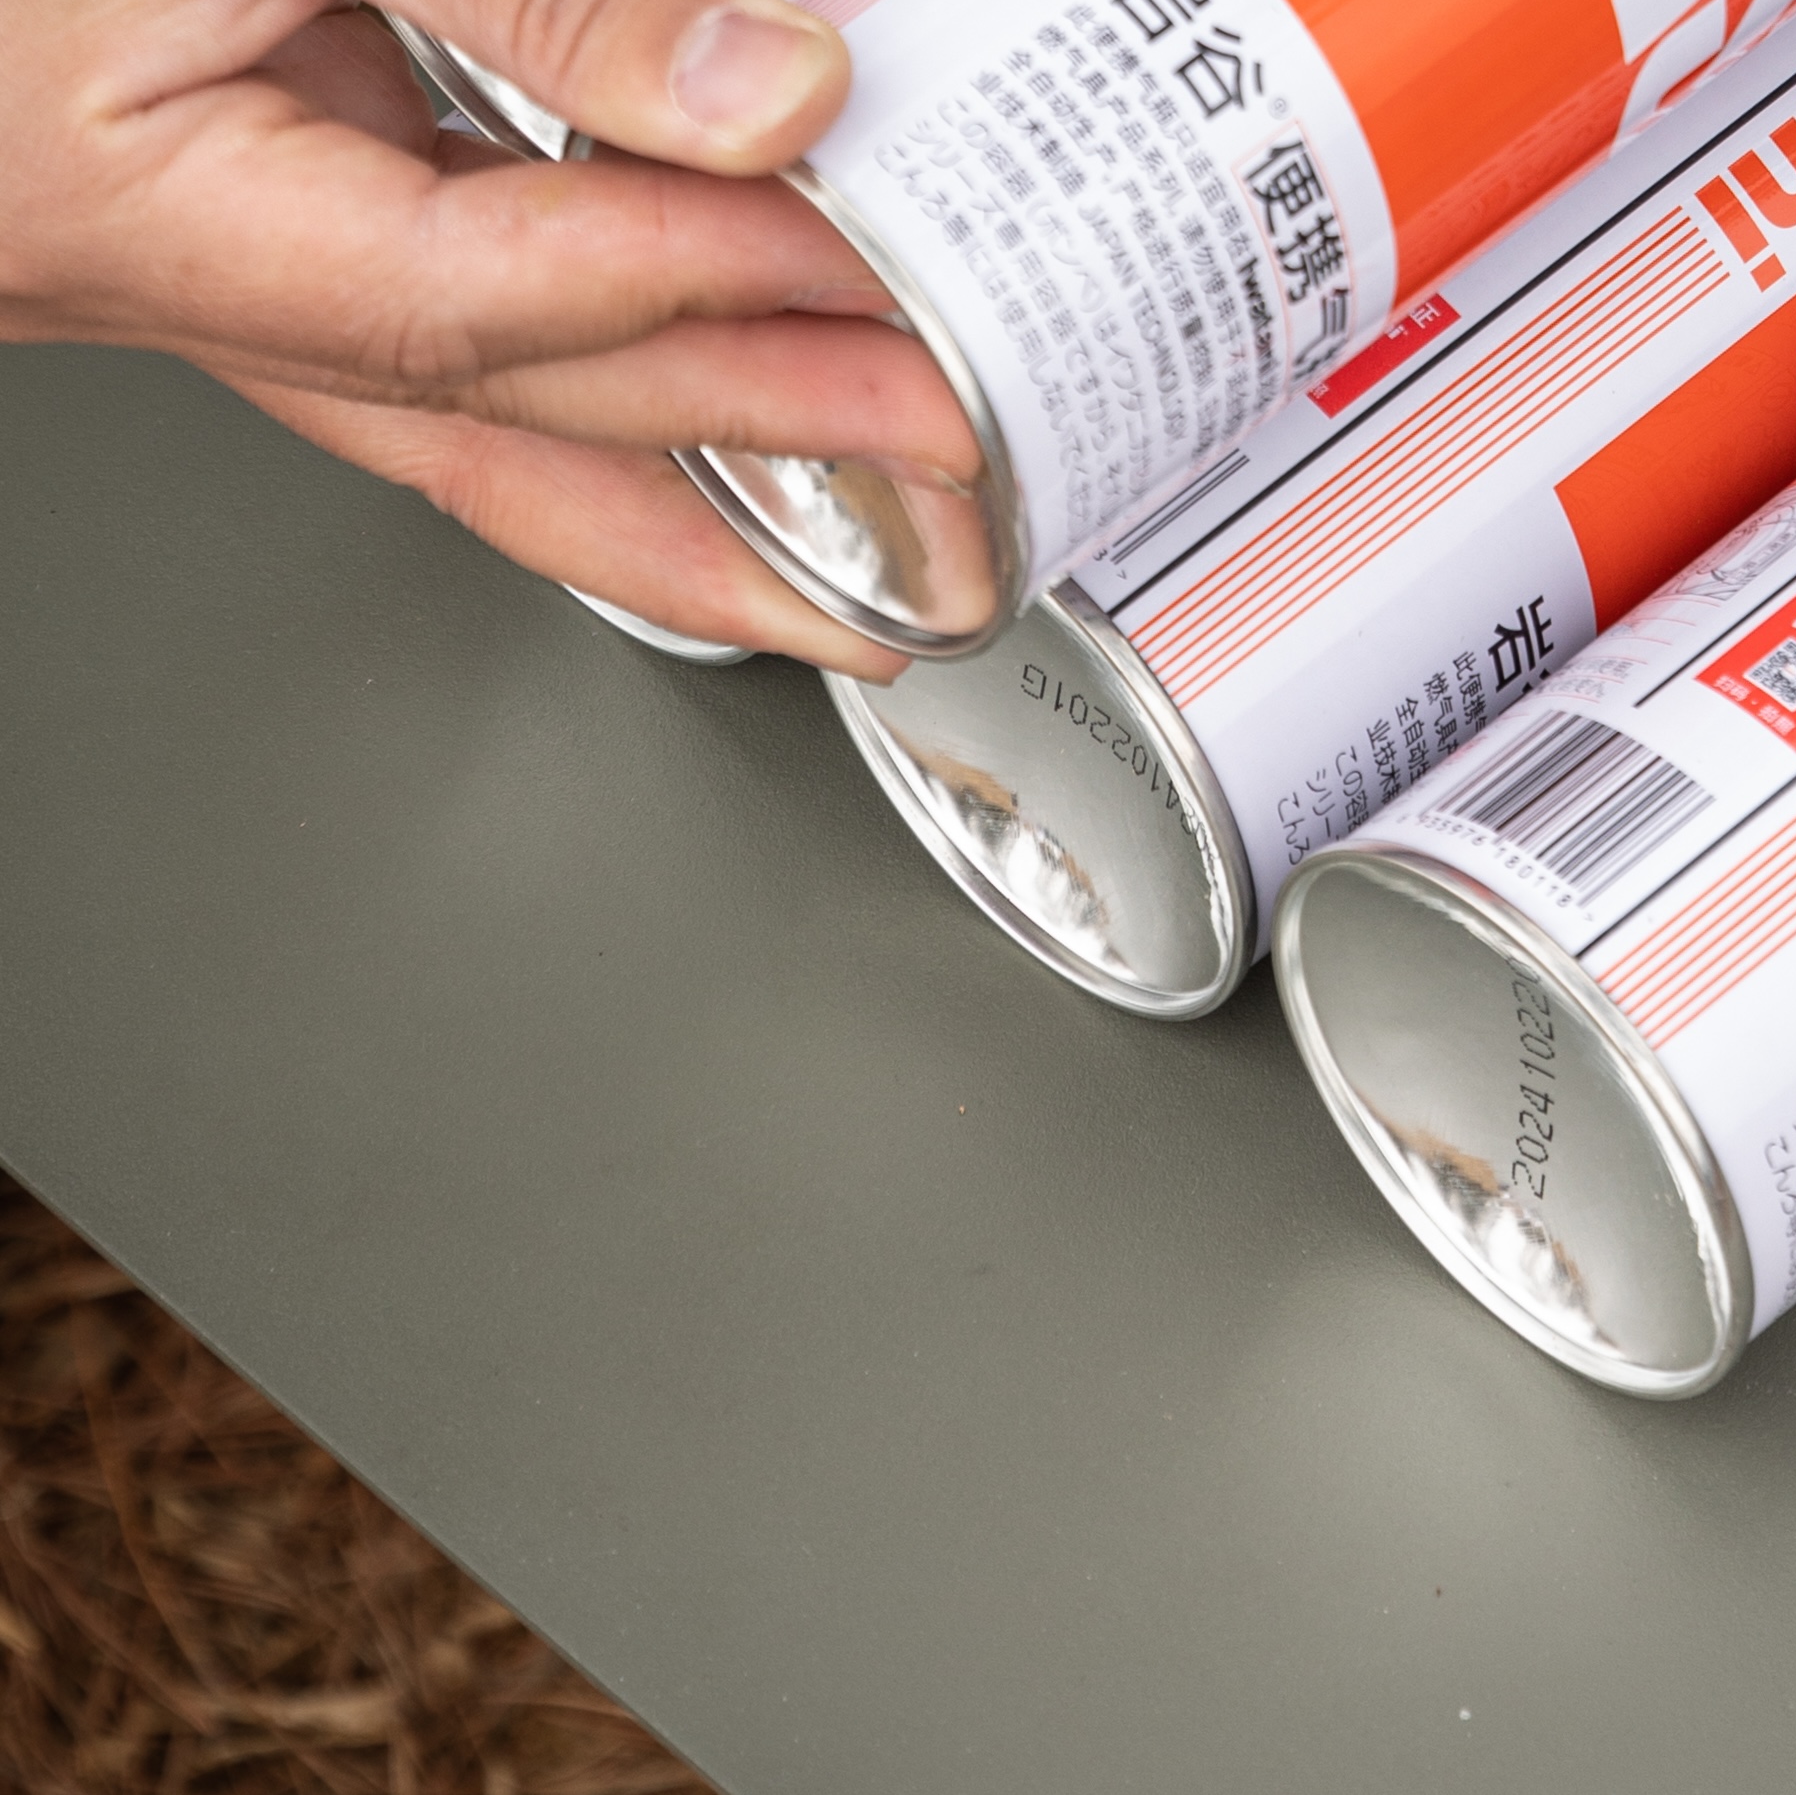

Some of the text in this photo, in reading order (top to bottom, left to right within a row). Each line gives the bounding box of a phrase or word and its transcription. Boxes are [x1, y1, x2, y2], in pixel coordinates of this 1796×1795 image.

[1240, 135, 1350, 386] 便携气
[1487, 594, 1554, 695] 岩
[1305, 771, 1342, 841] シリー
